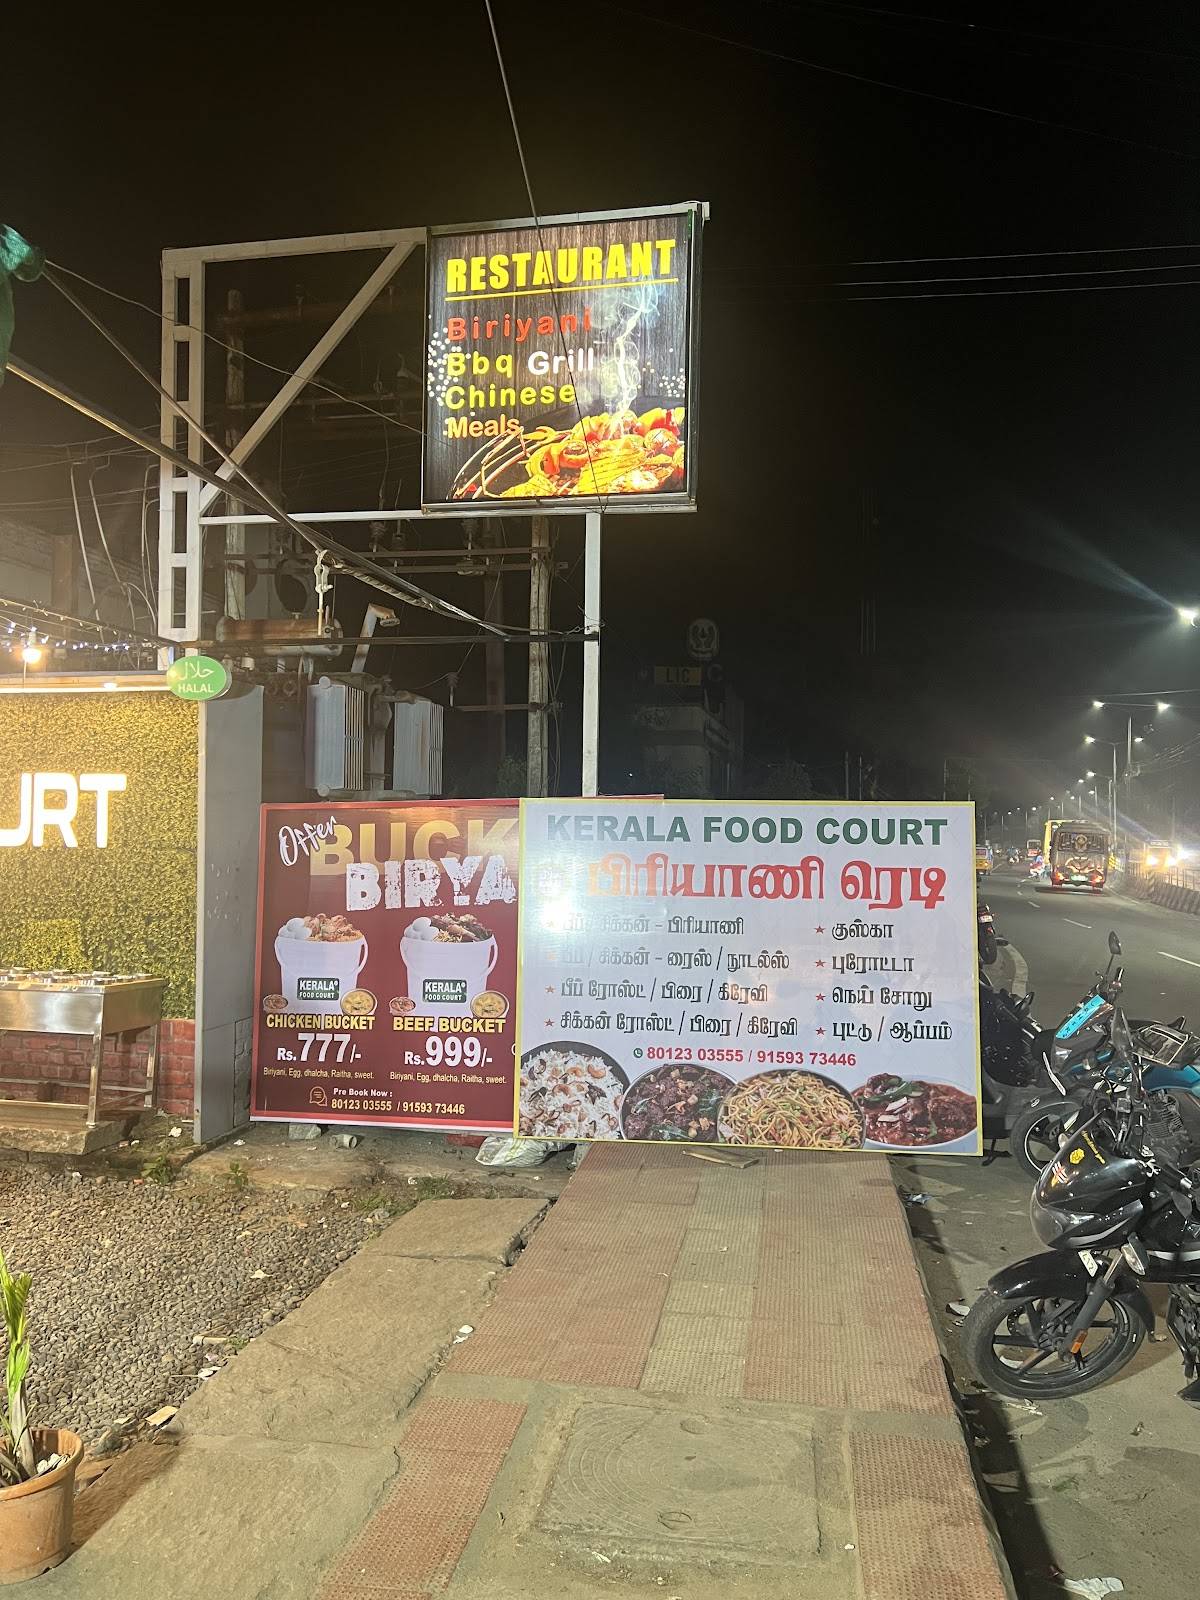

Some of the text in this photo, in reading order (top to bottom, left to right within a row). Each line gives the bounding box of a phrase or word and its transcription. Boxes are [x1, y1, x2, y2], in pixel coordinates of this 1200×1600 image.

[446, 239, 676, 292] RESTAURANT
[447, 307, 593, 342] Biriyani
[447, 347, 594, 378] Bbq Grill
[445, 383, 576, 410] Chinese
[447, 414, 521, 439] Meals
[177, 683, 214, 693] HALAL
[666, 668, 690, 683] LIC
[279, 816, 337, 867] Offer
[547, 815, 948, 846] KERALA FOOD COURT
[587, 852, 824, 899] பிரியாணி
[841, 860, 947, 910] ரெடி
[668, 915, 745, 935] பிரியாணி
[832, 918, 894, 940] குஸ்கா
[599, 946, 650, 966] சிக்கன்
[667, 948, 712, 970] ரைஸ்
[716, 946, 723, 970] /
[832, 953, 915, 974] புரோட்டா
[561, 978, 768, 1005] பீப் ரோஸ்ட் / பிரை / கிரேவி
[832, 984, 933, 1011] நெய் சோறு
[266, 1014, 375, 1030] CHICKEN BUCKET
[393, 1017, 506, 1033] BEEF BUCKET
[560, 1010, 798, 1038] சிக்கன் ரோஸ்ட் / பிரை / கிரேவி
[832, 1016, 953, 1043] புட்டு / ஆப்பம்
[647, 1046, 693, 1060] 80123
[697, 1048, 744, 1062] 03555
[757, 1050, 804, 1064] 91593
[809, 1052, 857, 1066] 73446
[349, 1088, 368, 1097] Book
[370, 1089, 388, 1097] Now
[331, 1099, 360, 1110] 80123
[363, 1100, 392, 1111] 03555
[403, 1101, 432, 1113] 91593
[435, 1103, 465, 1115] 73446
